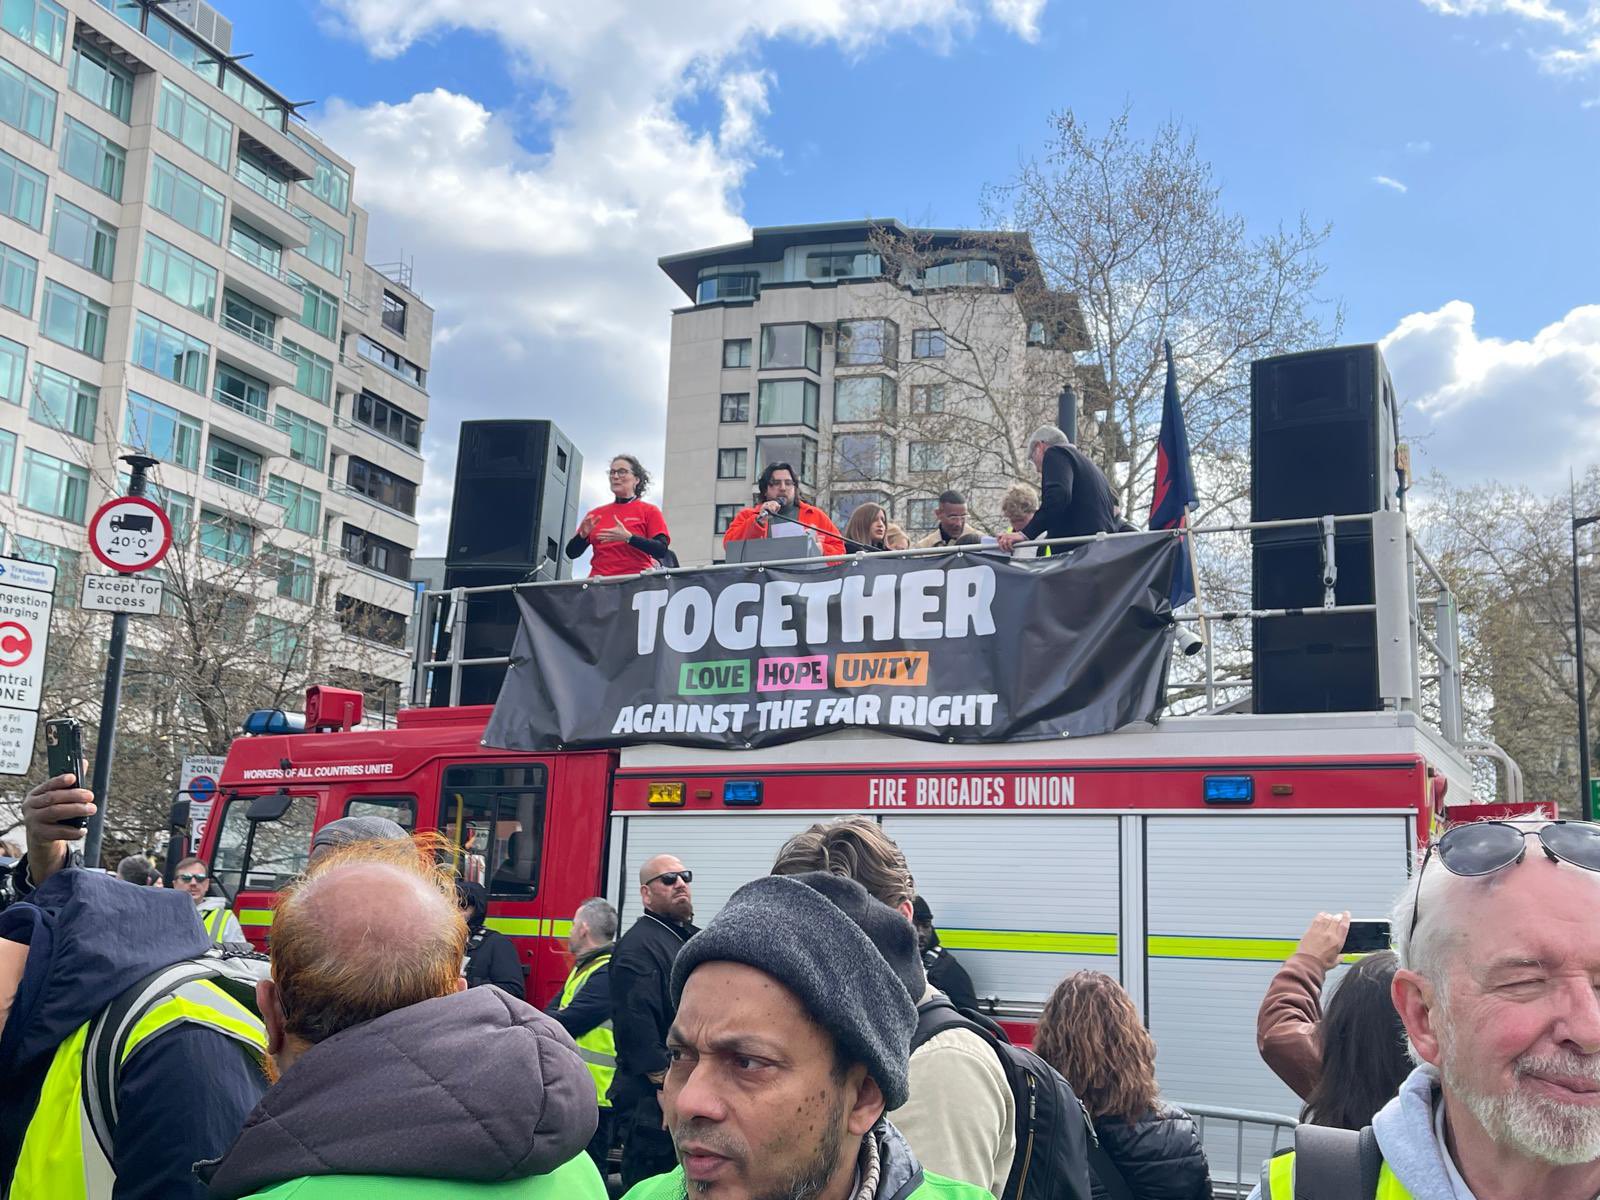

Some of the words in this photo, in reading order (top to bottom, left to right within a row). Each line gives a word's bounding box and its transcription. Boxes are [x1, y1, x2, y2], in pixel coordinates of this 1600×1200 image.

[10, 565, 45, 577] Transport
[23, 575, 48, 585] London
[88, 578, 136, 594] Except
[141, 583, 160, 595] for
[97, 595, 145, 607] access
[0, 606, 39, 620] arging
[632, 564, 996, 655] TOGETHER
[685, 664, 745, 690] LOVE
[762, 660, 823, 687] HOPE
[841, 656, 922, 682] UNITY
[0, 688, 25, 701] NE
[611, 703, 750, 735] AGAINST
[756, 699, 808, 732] THE
[814, 694, 882, 727] FAR
[888, 694, 998, 727] RIGHT
[190, 765, 219, 775] ZONE
[243, 769, 284, 779] WORKERS
[285, 768, 297, 778] OF
[297, 767, 313, 777] ALL
[314, 765, 364, 777] COUNTRIES
[869, 779, 907, 806] FIRE
[916, 777, 1005, 806] BRIGADES
[1014, 776, 1075, 806] UNION
